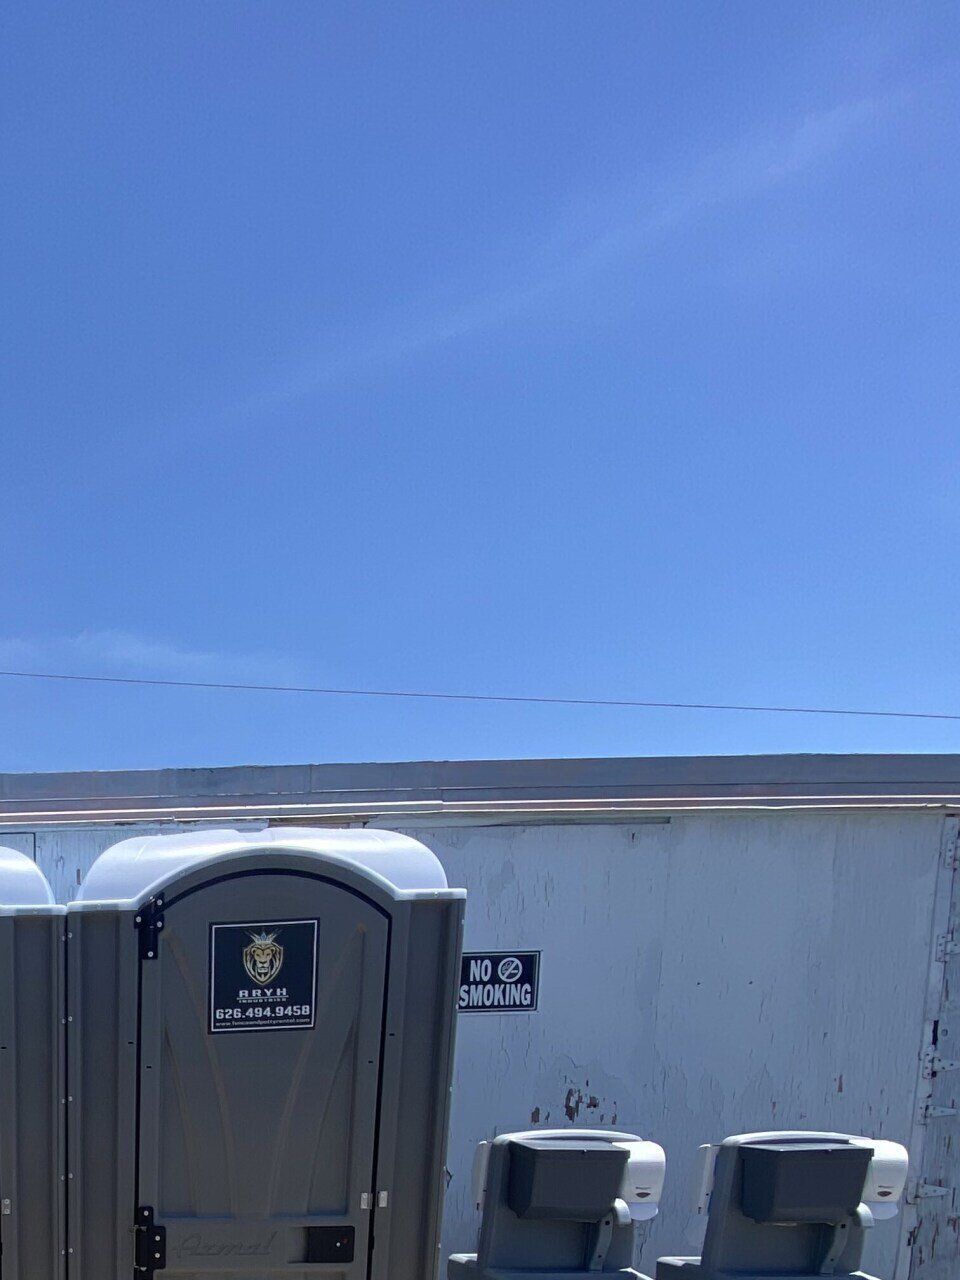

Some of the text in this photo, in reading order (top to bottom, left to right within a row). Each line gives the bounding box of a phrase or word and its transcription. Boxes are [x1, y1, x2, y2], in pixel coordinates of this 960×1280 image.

[469, 959, 492, 982] NO
[239, 987, 287, 998] ARYH
[459, 983, 532, 1007] SMOKING
[216, 1005, 310, 1020] 626.494.9458
